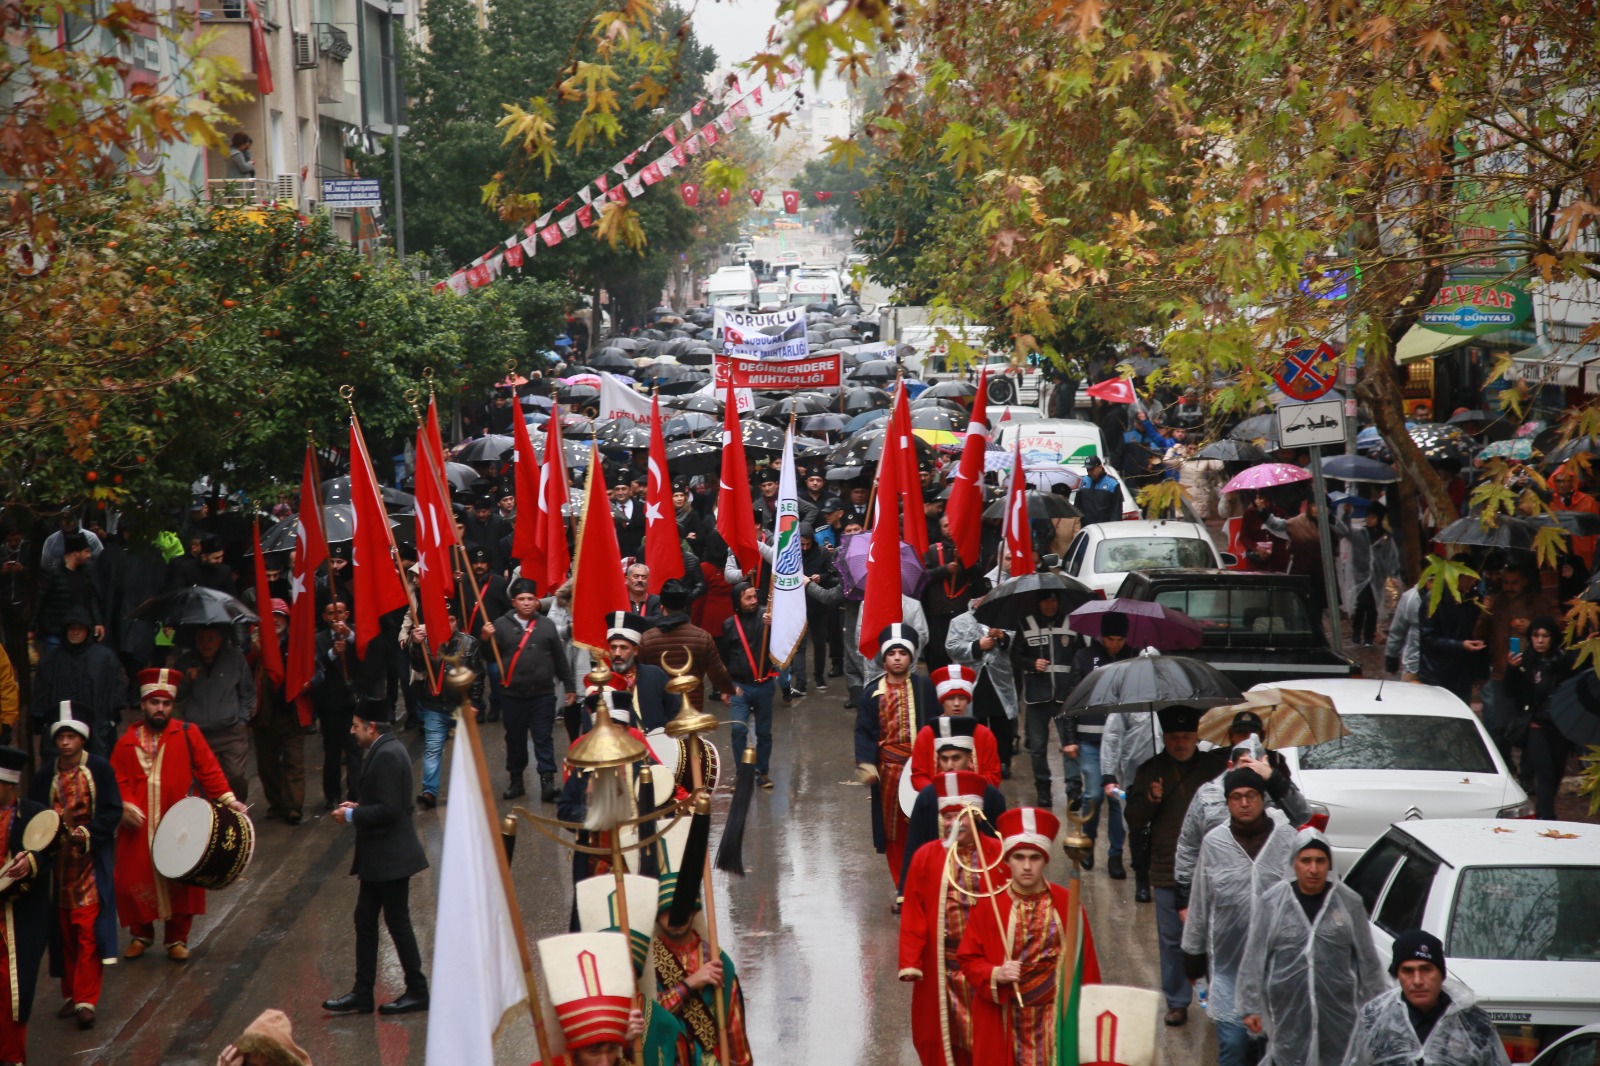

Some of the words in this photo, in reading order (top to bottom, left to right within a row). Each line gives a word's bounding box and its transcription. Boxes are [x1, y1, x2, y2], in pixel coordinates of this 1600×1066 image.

[1463, 312, 1511, 322] DÜNYASI
[739, 361, 835, 375] DEĞİRMENDERE
[748, 372, 825, 385] MUHTARLIĞI
